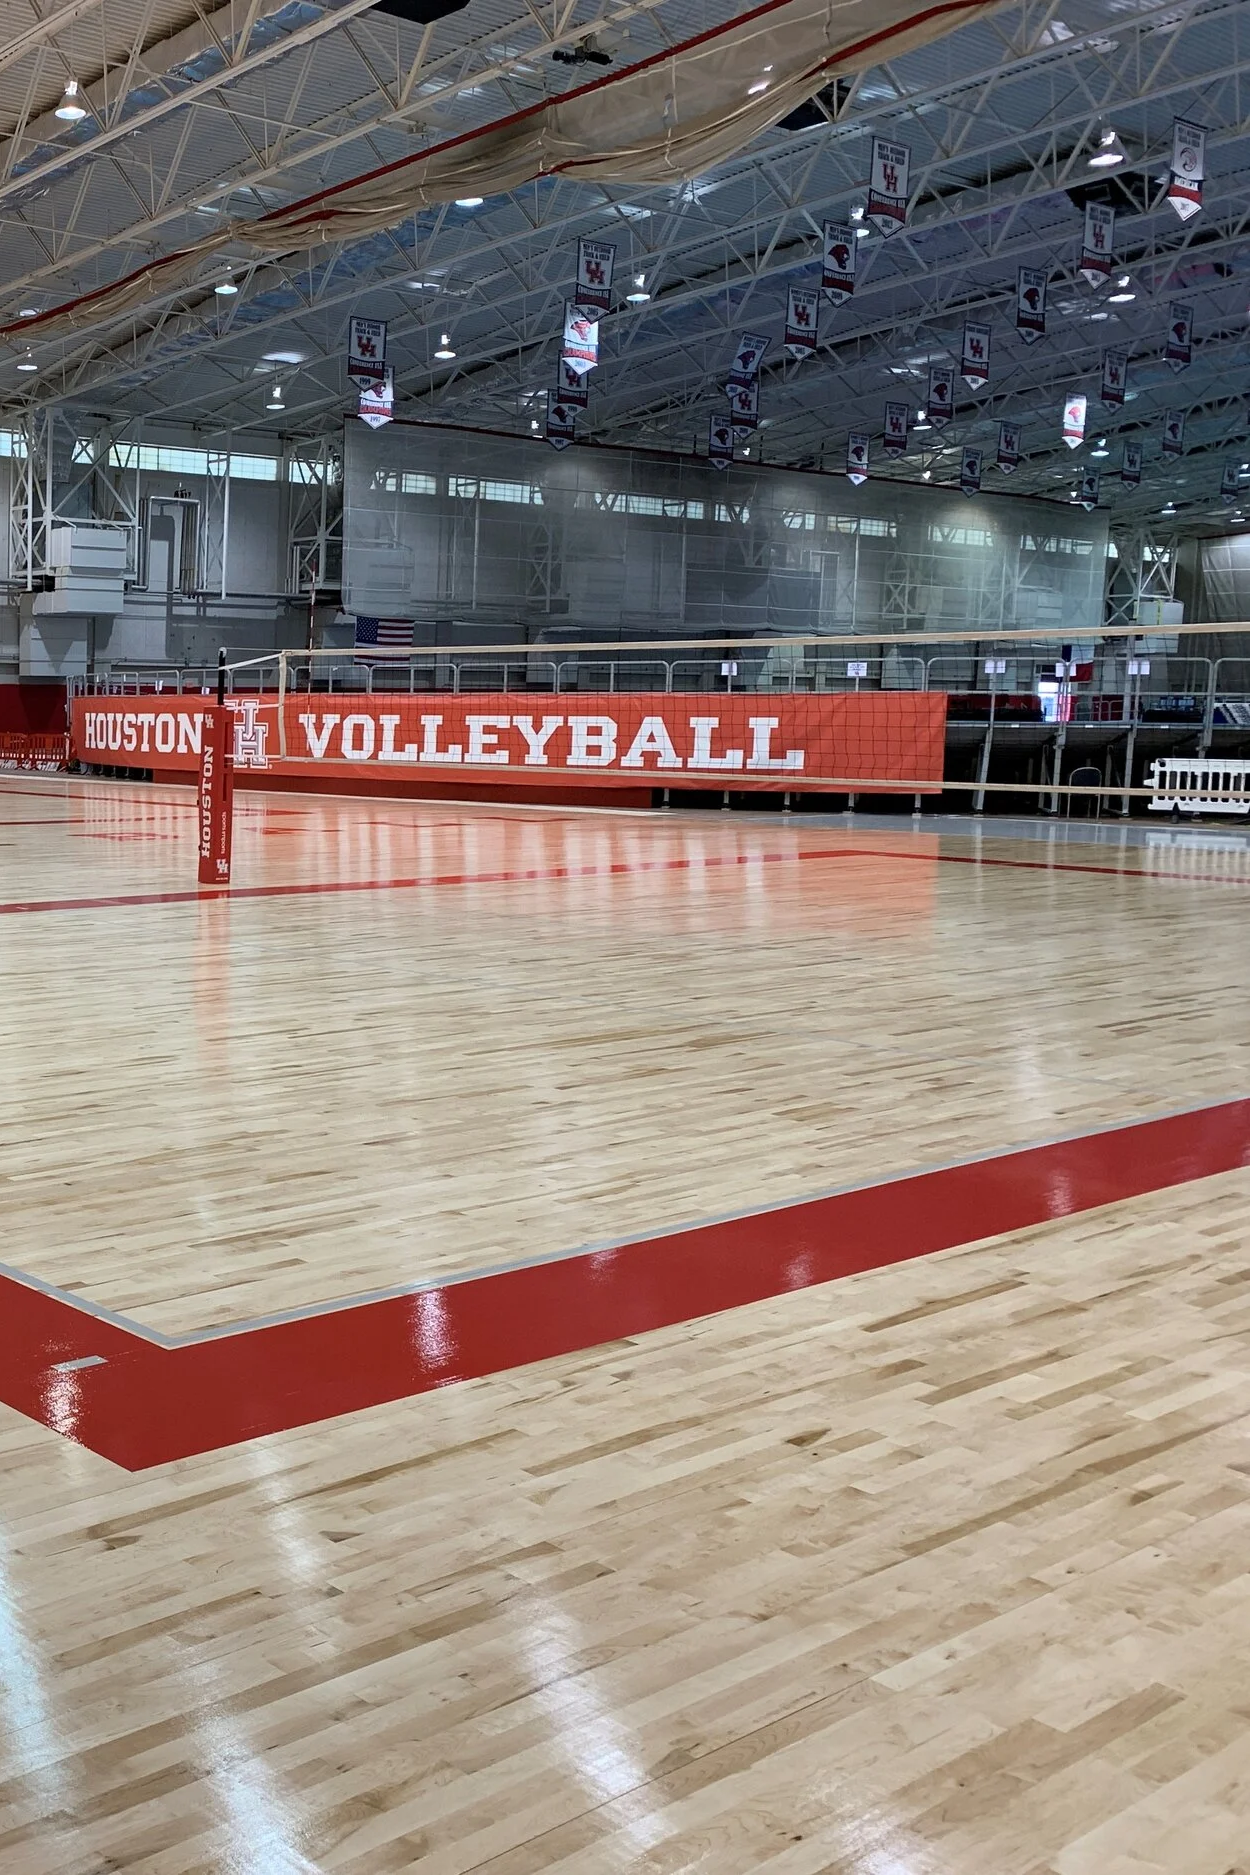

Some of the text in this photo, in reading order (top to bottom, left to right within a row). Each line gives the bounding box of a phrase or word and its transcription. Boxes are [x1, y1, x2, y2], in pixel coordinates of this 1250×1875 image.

[84, 712, 204, 754] HOUSTON
[298, 713, 805, 771] VOLLEYBALL
[201, 745, 214, 858] HOUSTON
